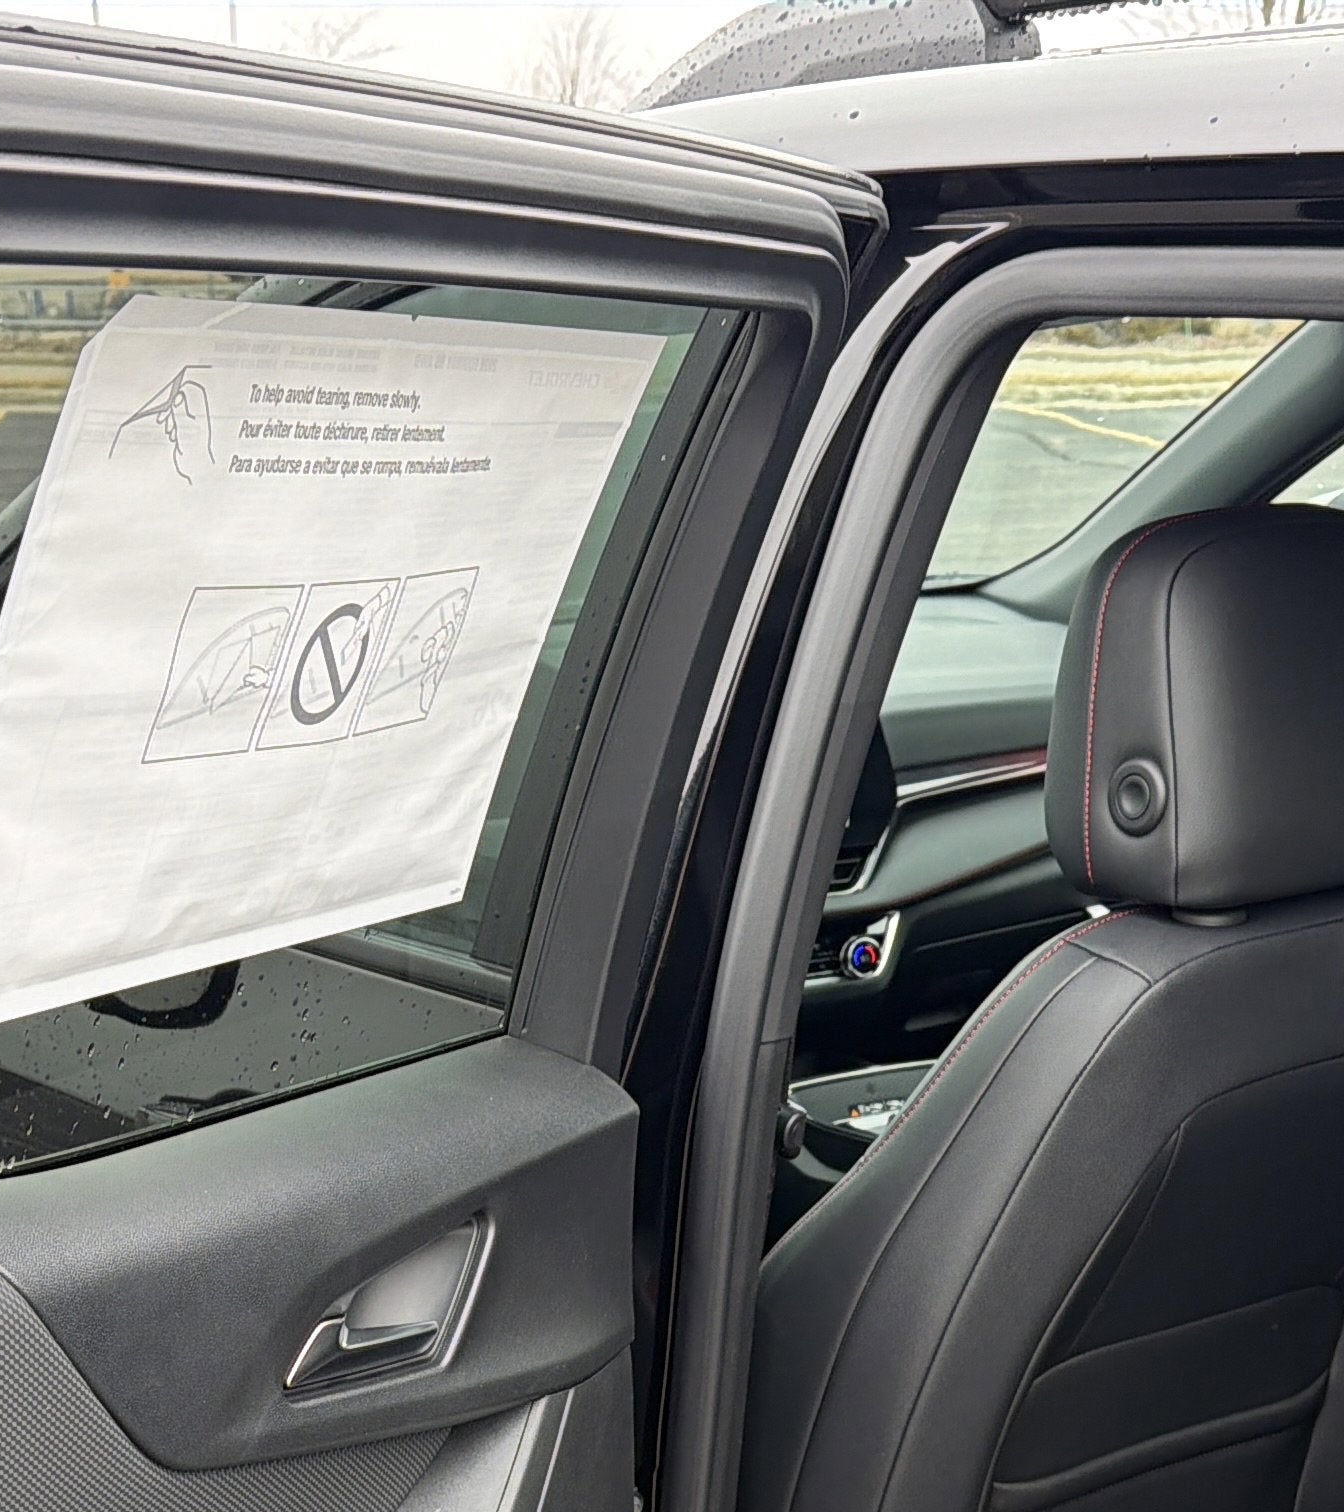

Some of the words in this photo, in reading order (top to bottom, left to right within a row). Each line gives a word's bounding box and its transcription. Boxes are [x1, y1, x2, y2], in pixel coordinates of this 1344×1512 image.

[249, 383, 262, 404] To
[261, 383, 285, 408] help
[284, 385, 316, 405] avoid
[315, 386, 350, 410] tearing,
[352, 391, 389, 408] remove
[389, 389, 421, 413] slowly.
[238, 419, 263, 439] Pour
[262, 417, 294, 439] éviter
[293, 421, 322, 440] toute
[370, 423, 402, 442] retirer
[228, 454, 253, 473] Para
[253, 454, 303, 478] ayudarse
[302, 459, 312, 475] a
[312, 456, 341, 475] evitar
[340, 459, 360, 478] que
[360, 460, 374, 475] se
